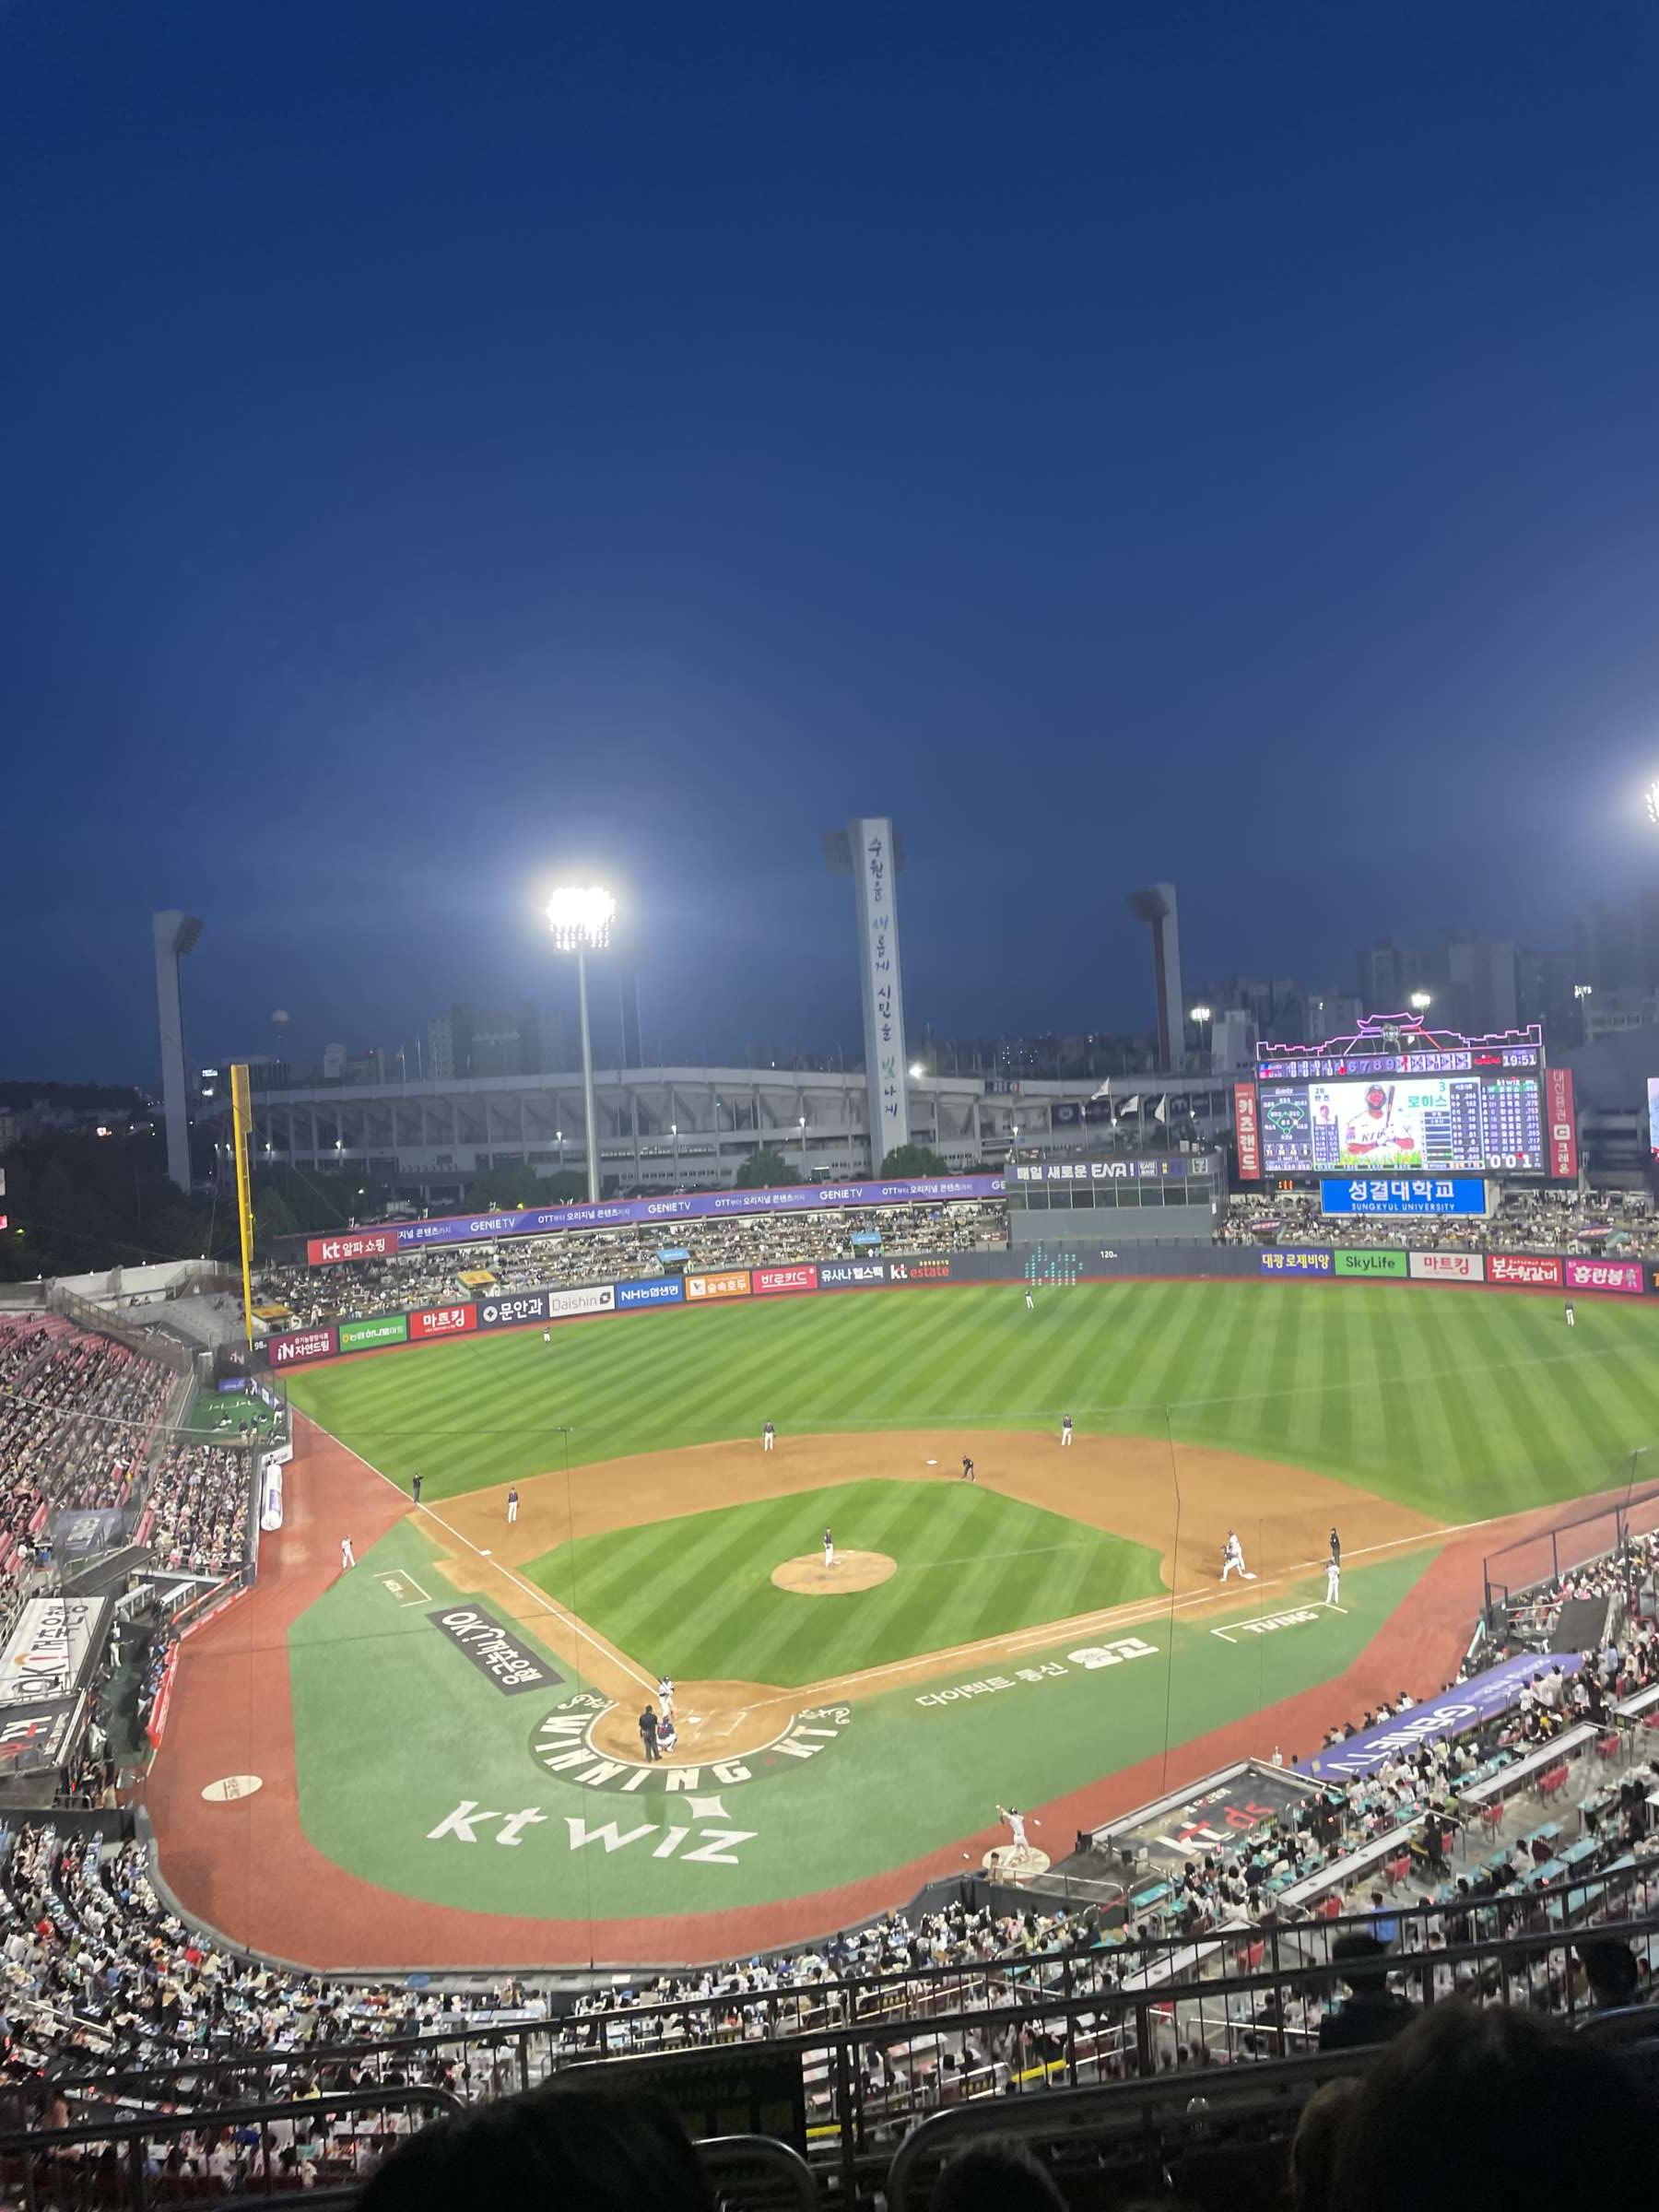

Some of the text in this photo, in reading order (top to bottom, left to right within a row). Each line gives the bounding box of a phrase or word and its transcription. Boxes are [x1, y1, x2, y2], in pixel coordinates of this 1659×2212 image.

[1502, 1053, 1536, 1067] 19:51
[1439, 1081, 1446, 1092] 3
[1407, 1094, 1448, 1108] 로하스
[1238, 1098, 1257, 1171] 키즈랜드
[1490, 1154, 1532, 1169] 0 0 1
[1017, 1166, 1042, 1181] 매일
[1047, 1164, 1088, 1179] 새로운
[819, 1188, 864, 1200] GENIE TV
[910, 1184, 938, 1194] 오리지널
[1348, 1180, 1454, 1202] 성결대학교
[648, 1201, 691, 1214] GENIE TV
[743, 1194, 771, 1206] 오리지널
[1352, 1203, 1455, 1212] SUNGKYUL UNIVERSITY
[566, 1210, 595, 1221] 오리지널
[470, 1218, 516, 1232] GENIE TV
[323, 1238, 385, 1260] kt 알파 쇼핑
[1262, 1253, 1330, 1269] 대광 로제비앙
[1346, 1256, 1395, 1271] SkyLife
[1424, 1256, 1469, 1275] 마트킹
[821, 1268, 853, 1282] 유사나
[890, 1263, 908, 1279] kt
[911, 1267, 949, 1277] estate
[499, 1298, 544, 1322] 문안과
[552, 1295, 597, 1312] Daishin
[423, 1309, 465, 1328] 마트킹
[915, 1676, 1017, 1707] 다이렉트
[1015, 1662, 1068, 1682] 통신
[771, 1725, 840, 1759] KT
[1327, 1704, 1477, 1773] GENIE TV
[535, 1712, 753, 1792] WINNING
